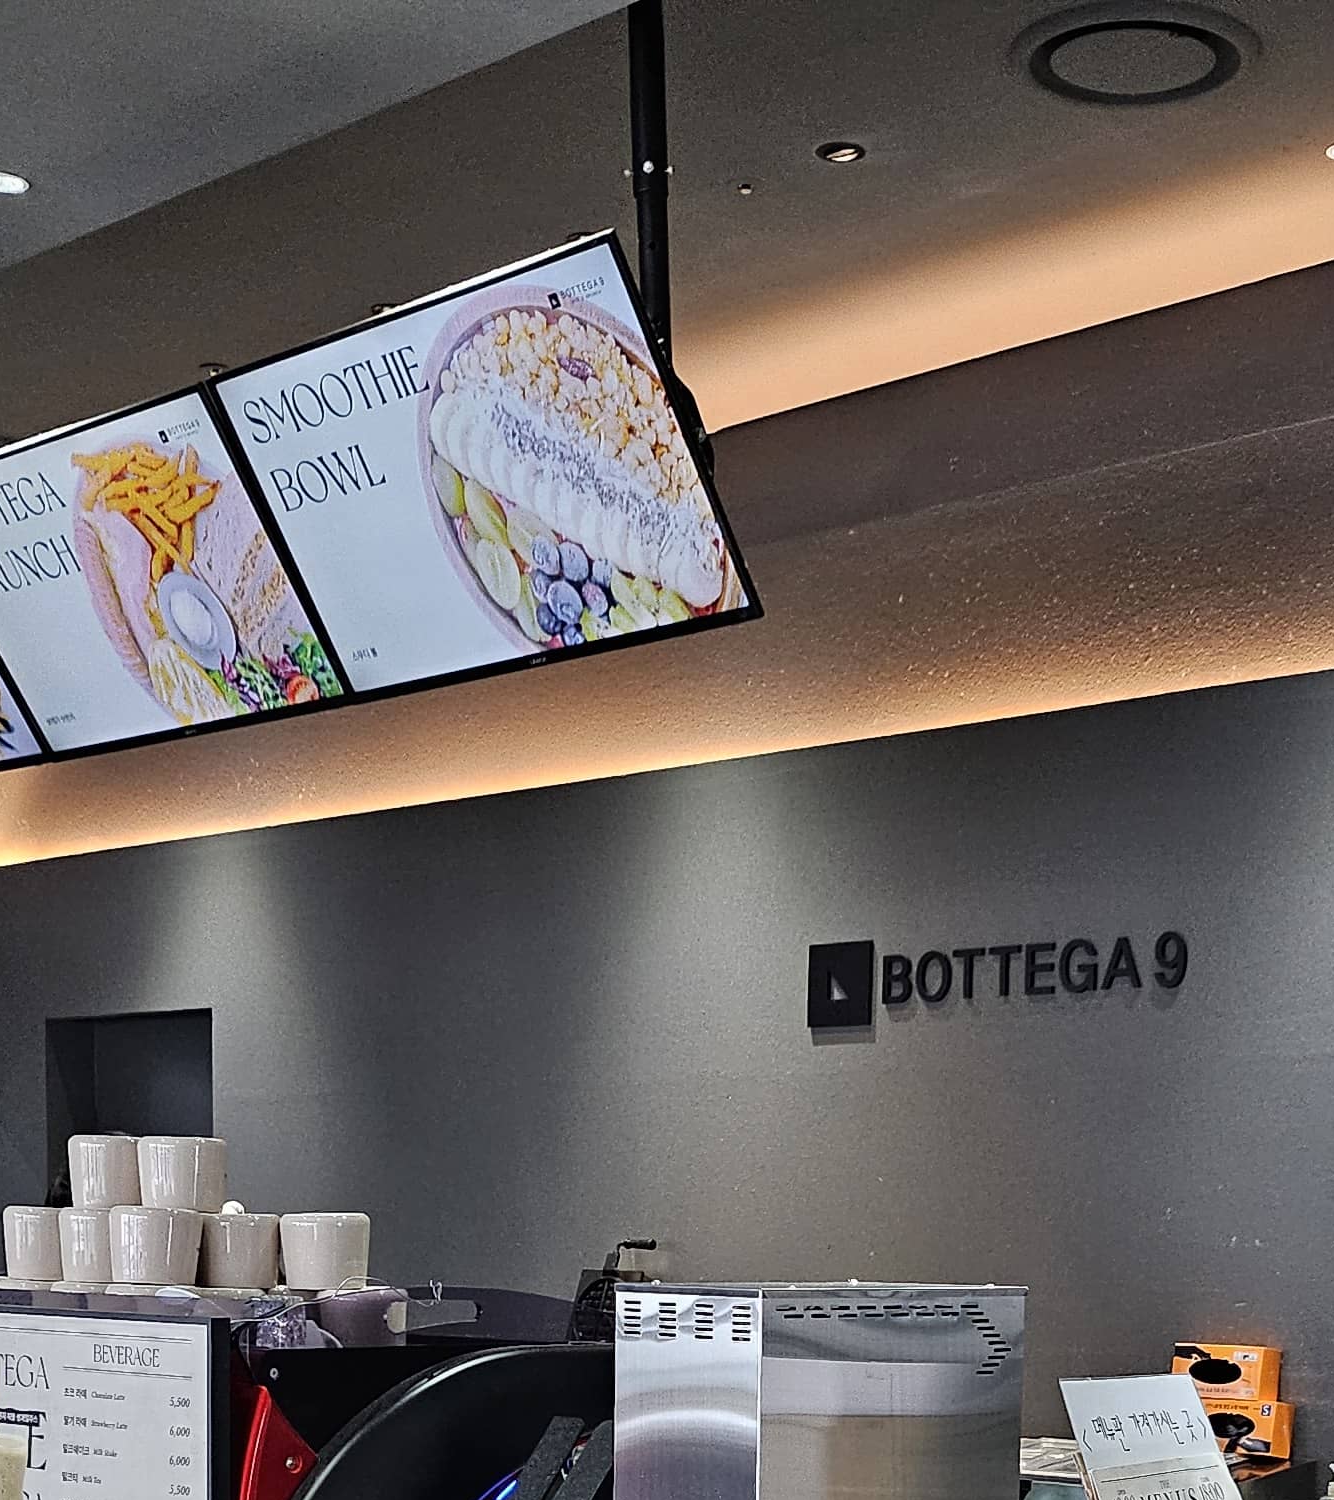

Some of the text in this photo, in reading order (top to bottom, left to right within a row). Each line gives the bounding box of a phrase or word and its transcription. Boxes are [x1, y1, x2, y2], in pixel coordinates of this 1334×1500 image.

[243, 345, 431, 444] SMOOTHIE
[269, 444, 387, 512] BOWL
[880, 931, 1189, 1005] BOTTEGA 9
[92, 1343, 161, 1367] BEVERAGE
[169, 1396, 191, 1408] 5,500
[169, 1425, 191, 1438] 6,000
[169, 1454, 191, 1467] 6,000
[168, 1484, 191, 1497] 5,500
